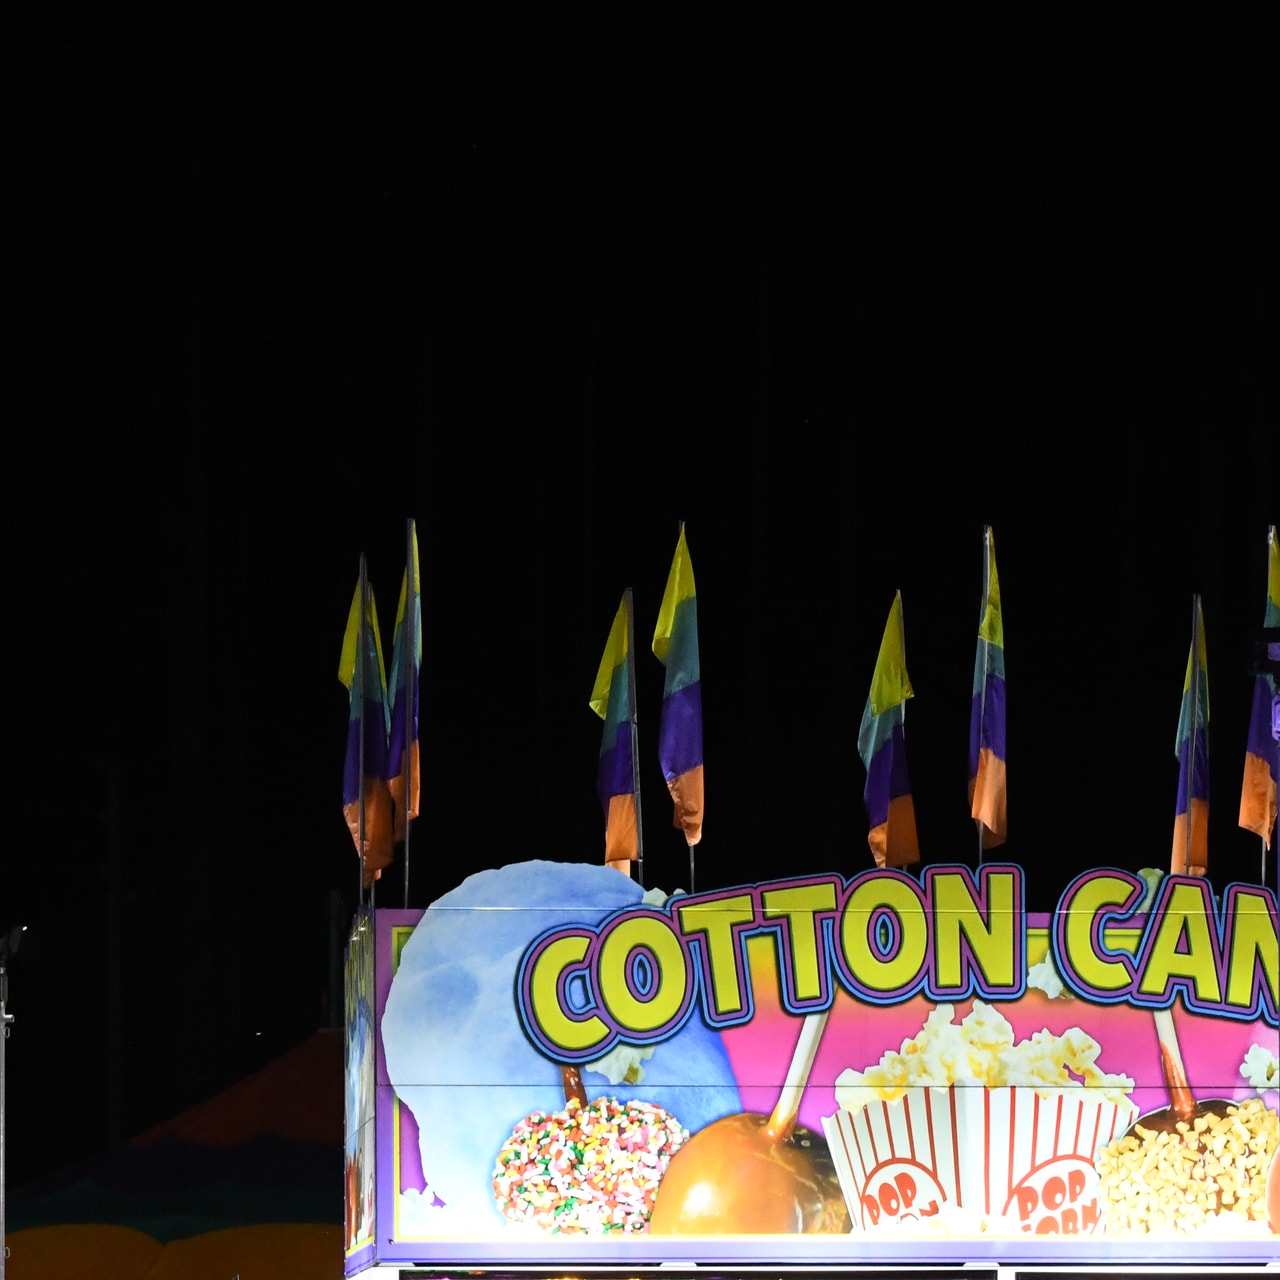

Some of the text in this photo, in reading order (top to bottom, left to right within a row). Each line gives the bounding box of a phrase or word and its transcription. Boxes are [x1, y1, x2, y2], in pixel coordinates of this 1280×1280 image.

[523, 868, 1020, 1058] COTTON
[863, 1171, 917, 1226] POP
[1016, 1168, 1087, 1222] POP
